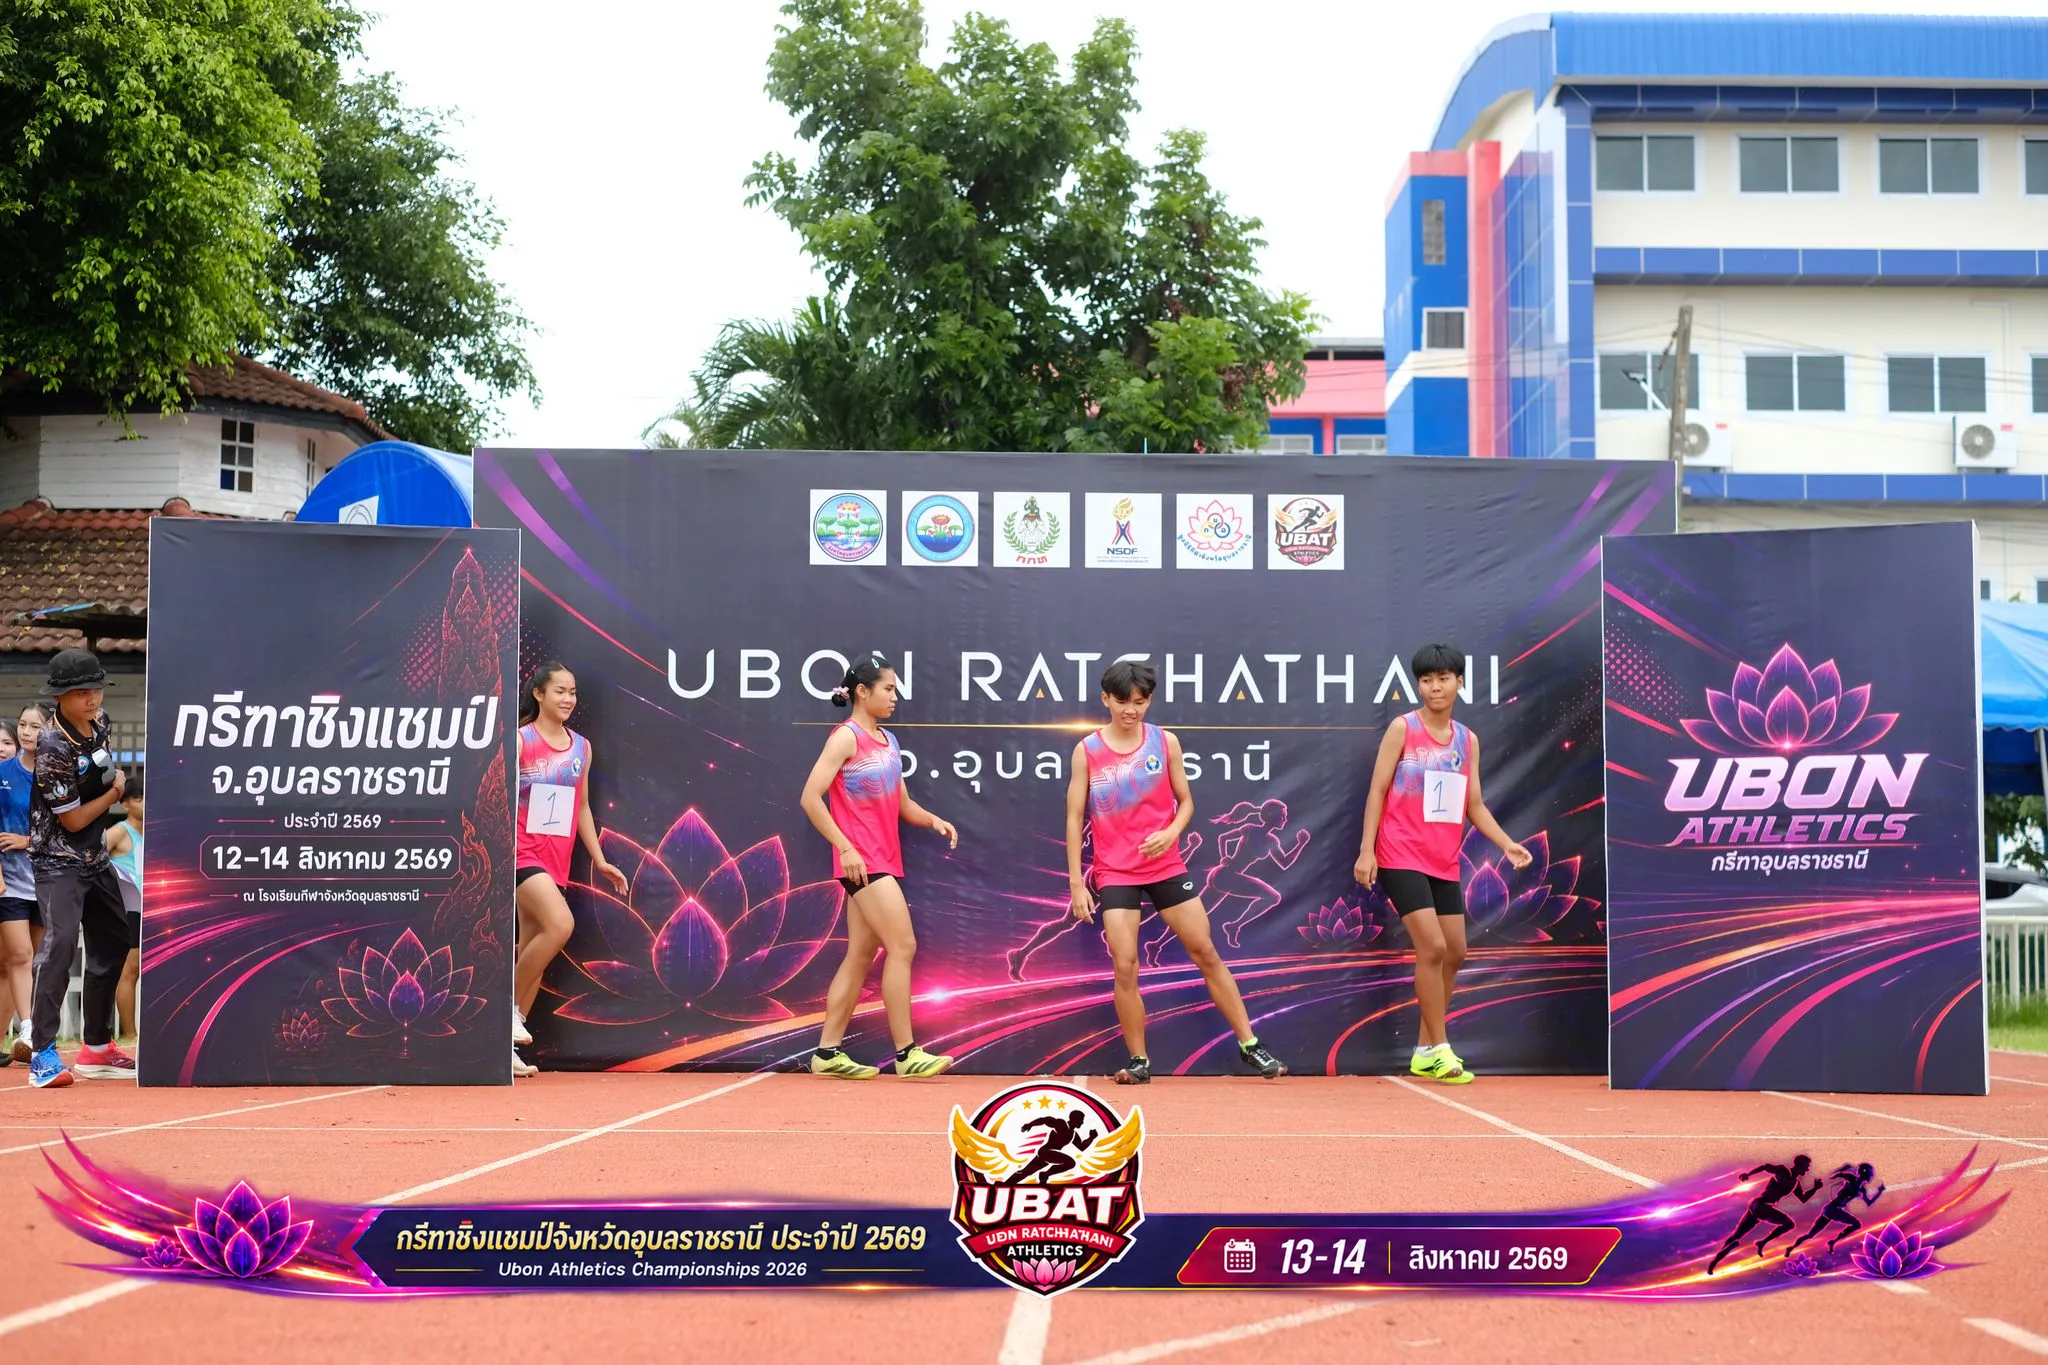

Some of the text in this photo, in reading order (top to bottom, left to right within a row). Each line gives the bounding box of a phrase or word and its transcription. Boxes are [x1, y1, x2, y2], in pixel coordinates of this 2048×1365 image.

[1106, 547, 1139, 555] NSDF
[1280, 532, 1333, 546] UBAT
[961, 651, 1499, 704] RATHATHAI
[173, 691, 499, 749] กรีฑาชิงแชมป์
[212, 757, 451, 805] จ.อุบลราชธานี
[1431, 780, 1447, 813] 1
[1664, 753, 1930, 811] UBON
[284, 811, 382, 829] ประจำปี 2569
[542, 792, 560, 825] 1
[1669, 814, 1921, 846] ATHLETICS
[298, 845, 386, 870] สิงหาคม
[394, 848, 453, 870] 2569
[1711, 848, 1870, 876] กรีฑาอุบลราชธานี
[243, 892, 255, 902] ณ
